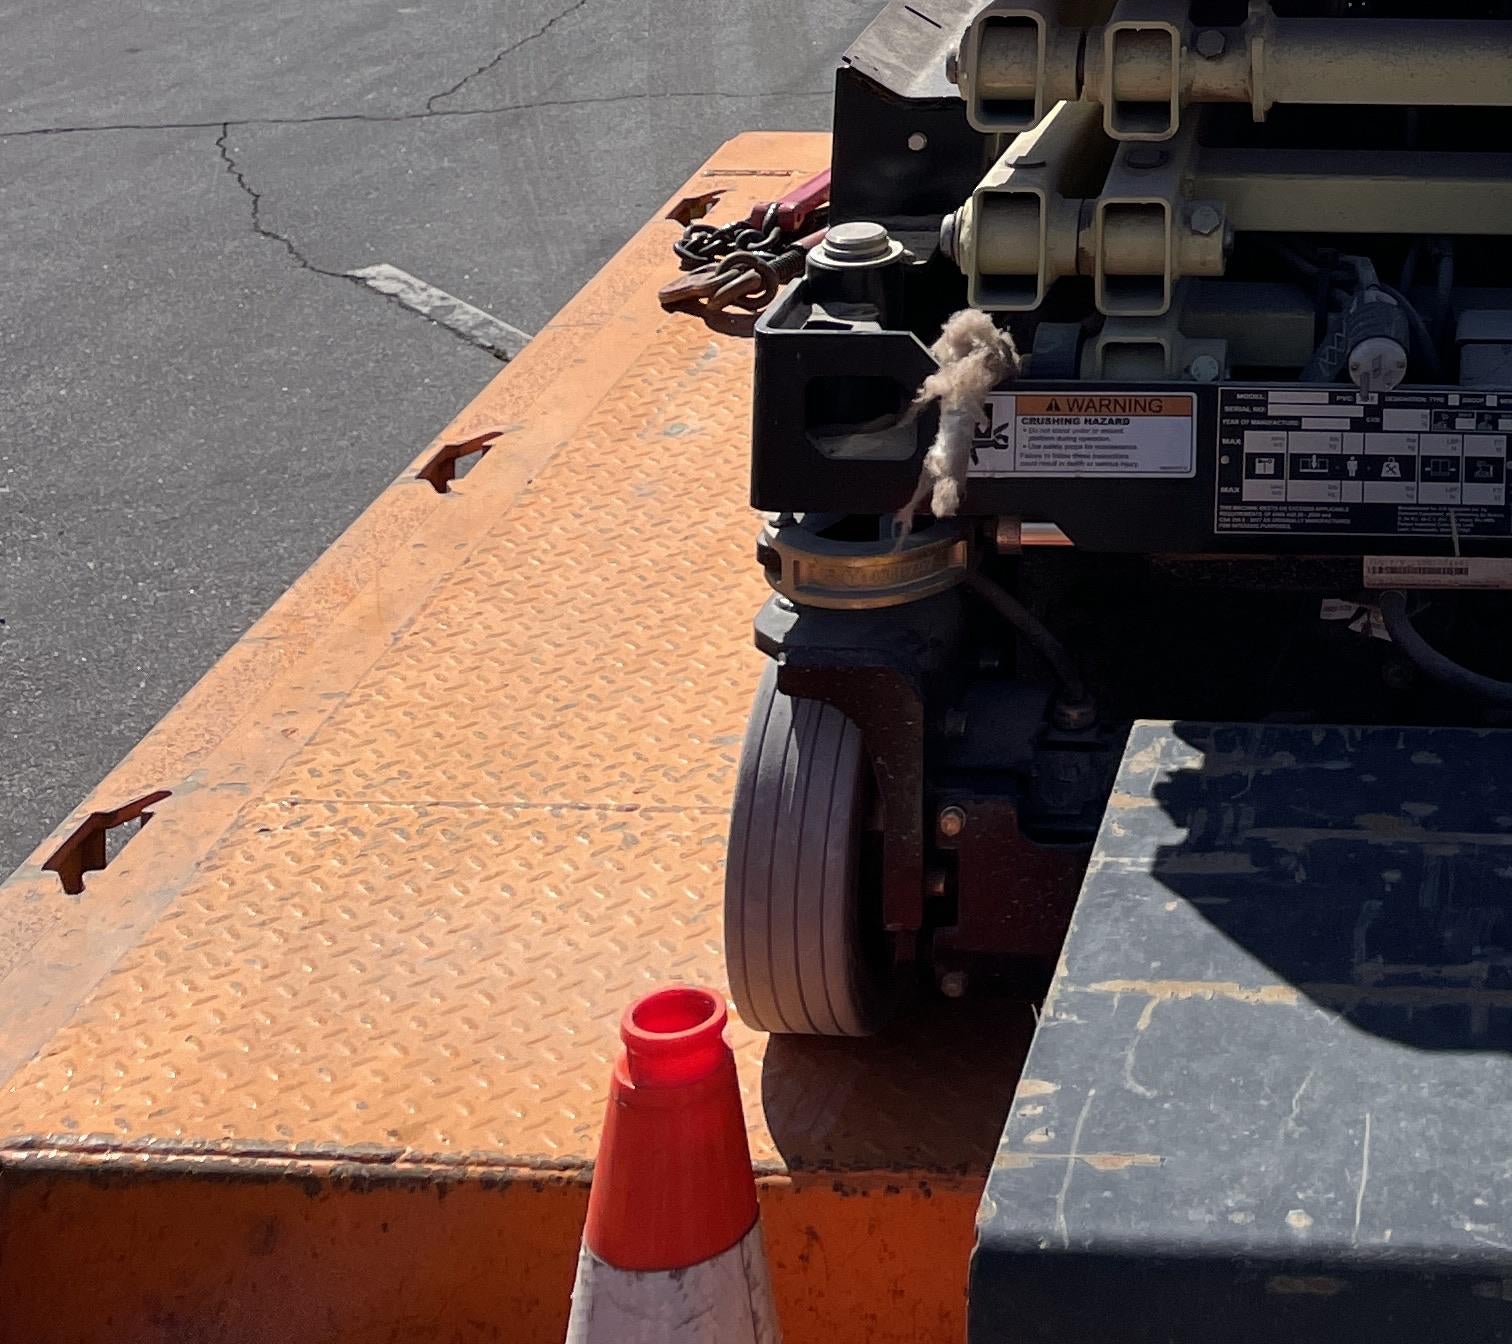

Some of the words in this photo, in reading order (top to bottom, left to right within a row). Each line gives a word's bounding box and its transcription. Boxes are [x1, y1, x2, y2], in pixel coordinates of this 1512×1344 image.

[1067, 398, 1164, 413] WARNING
[1021, 417, 1081, 426] CRUSHING
[1084, 417, 1130, 426] HAZARD
